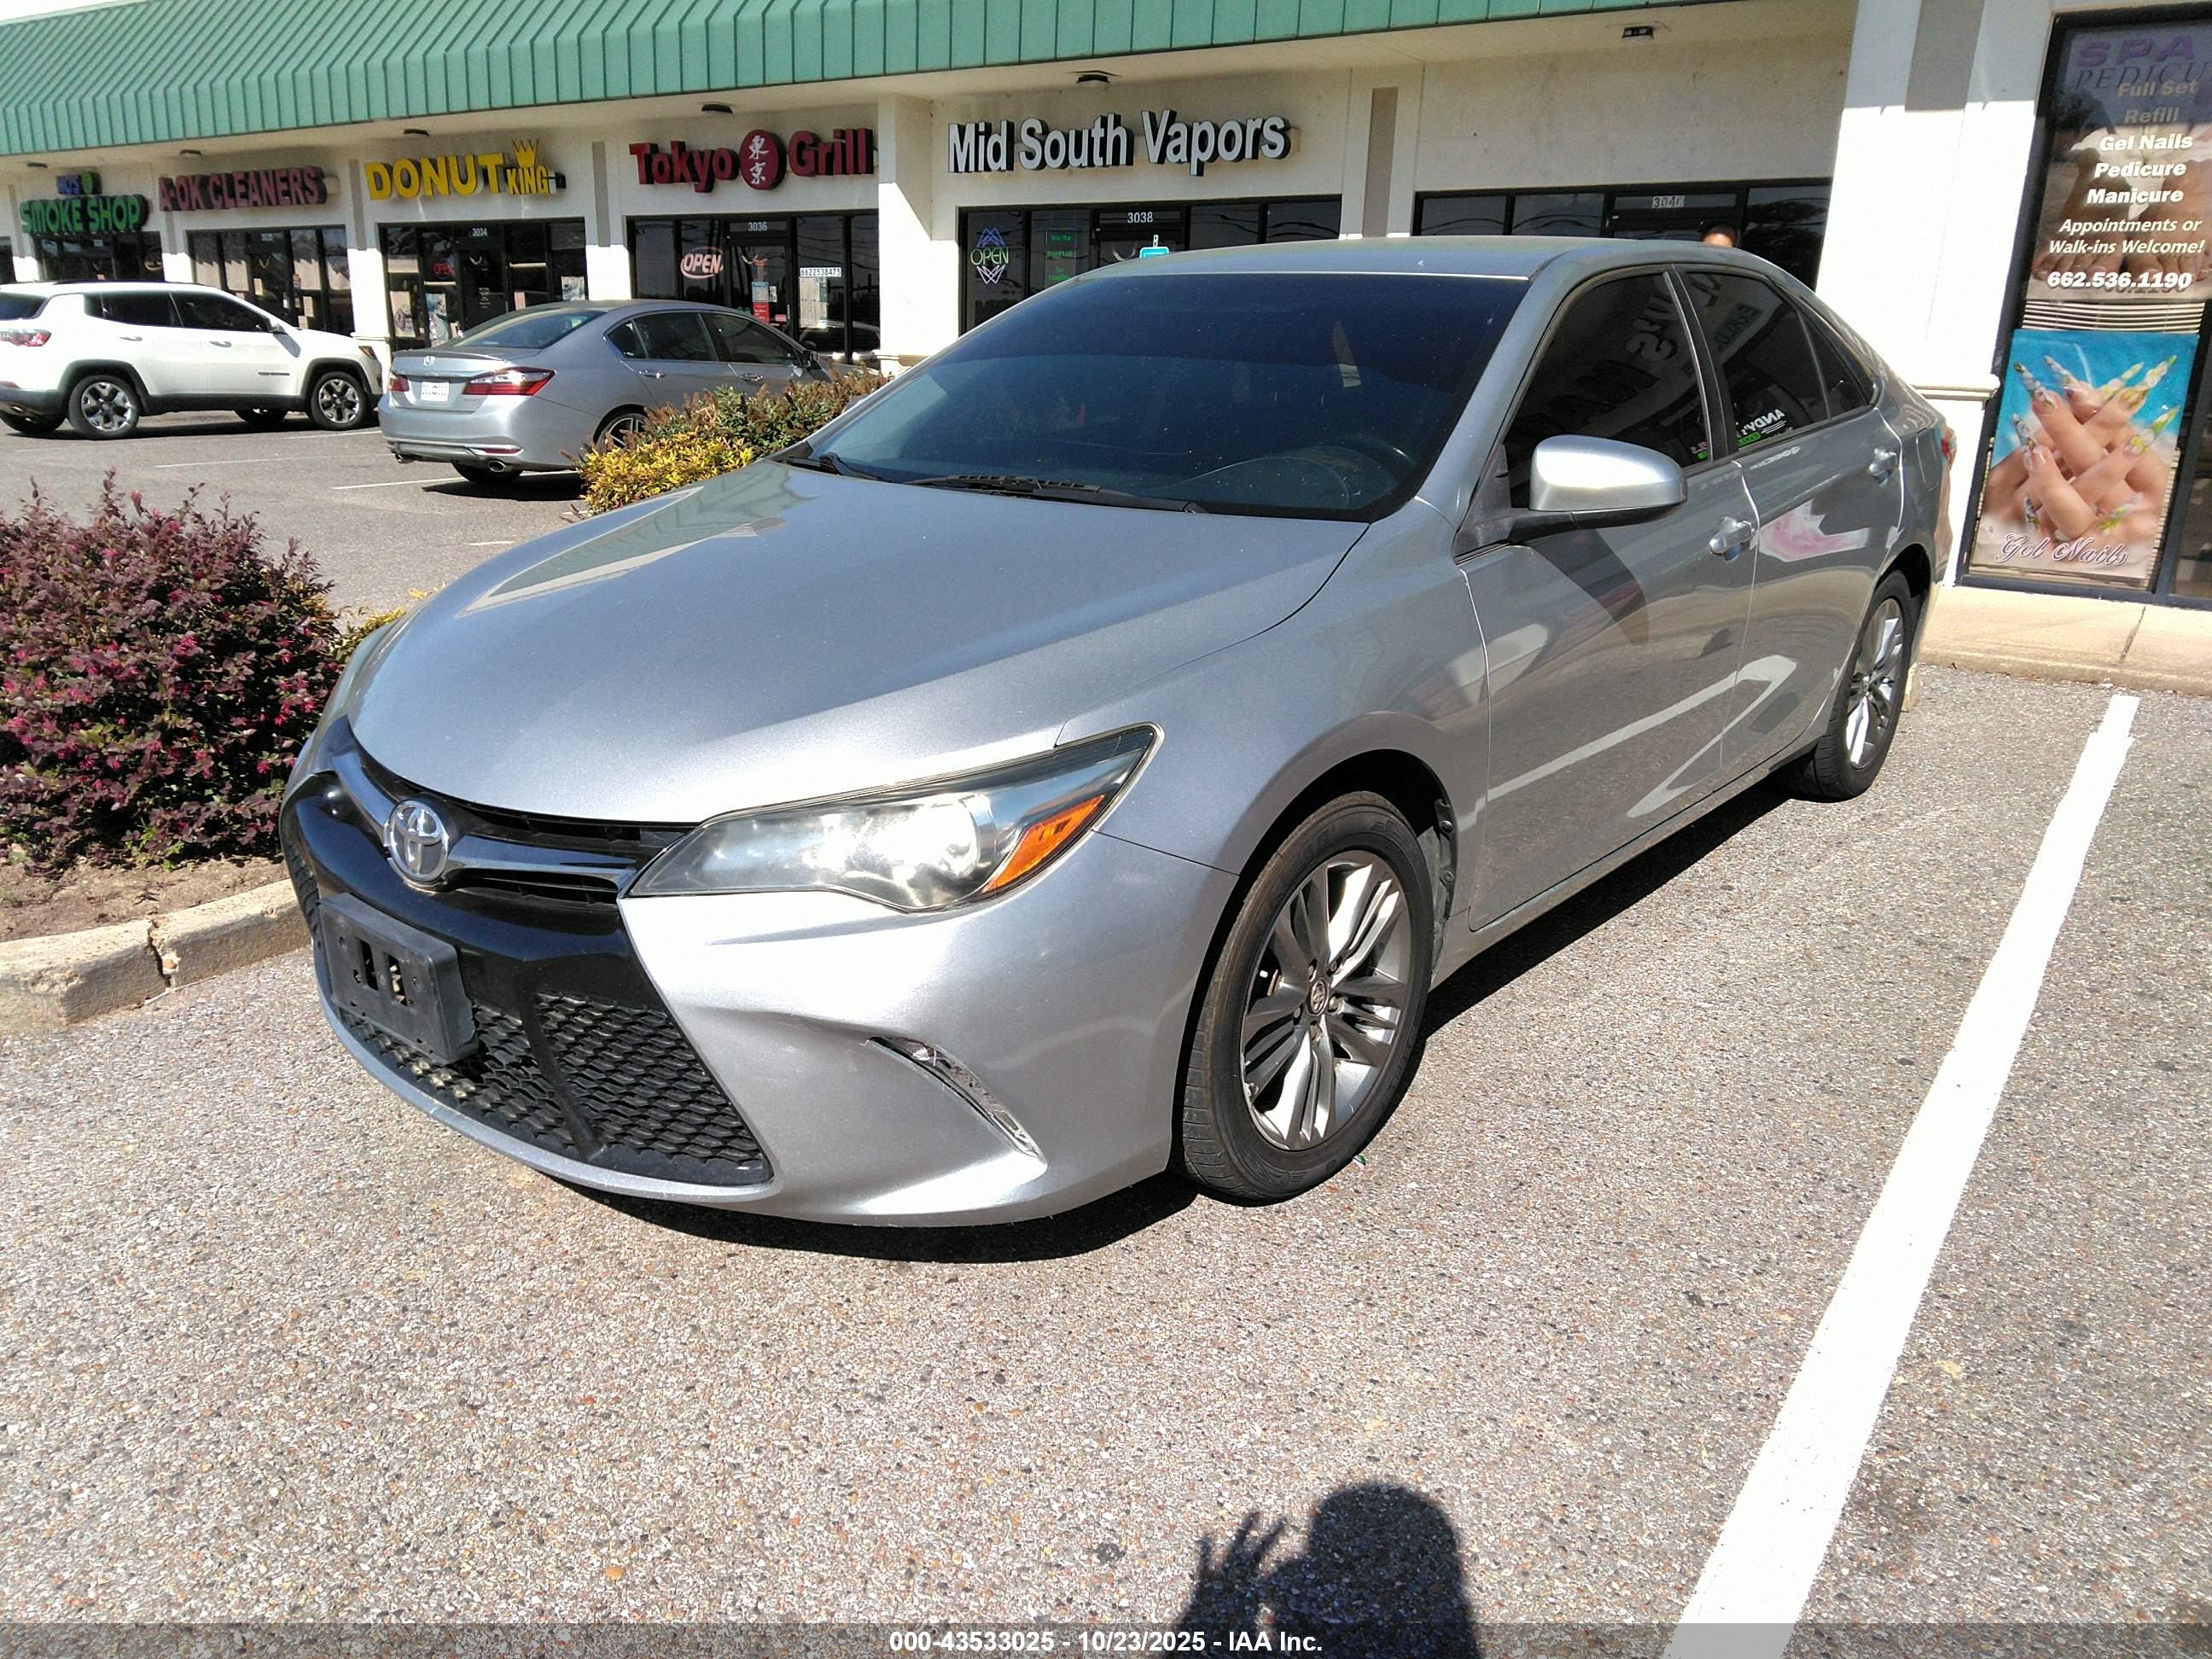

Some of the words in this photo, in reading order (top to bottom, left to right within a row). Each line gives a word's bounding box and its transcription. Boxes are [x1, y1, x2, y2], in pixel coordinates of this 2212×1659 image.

[2075, 35, 2194, 67] SPA
[2072, 61, 2212, 91] PEDICU
[2118, 83, 2156, 98] Full
[2163, 80, 2198, 96] Set
[2124, 107, 2180, 125] Refill
[789, 128, 873, 178] Grill
[948, 119, 1013, 172] Mid
[1018, 113, 1132, 170] South
[1140, 109, 1289, 177] Vapors
[2099, 135, 2134, 152] Gel
[2139, 133, 2194, 151] Nails
[365, 153, 505, 200] DONUT
[629, 139, 734, 193] Tokyo
[2094, 160, 2186, 178] Pedicure
[207, 166, 321, 210] CLEANERS
[506, 164, 550, 195] KING
[2087, 189, 2185, 205] Manicure
[19, 198, 83, 233] SMOKE
[86, 195, 143, 232] SHOP
[1126, 212, 1154, 224] 3038
[748, 221, 768, 232] 3036
[2058, 218, 2178, 236] Appointments
[2182, 218, 2203, 231] or
[969, 246, 1010, 266] OPEN
[2048, 239, 2116, 255] Walk-ins
[2122, 238, 2205, 253] Welcome!
[683, 253, 722, 275] OPEN
[2047, 271, 2193, 288] 662.536.1190
[1994, 533, 2052, 563] Gel
[2052, 537, 2128, 566] Nails
